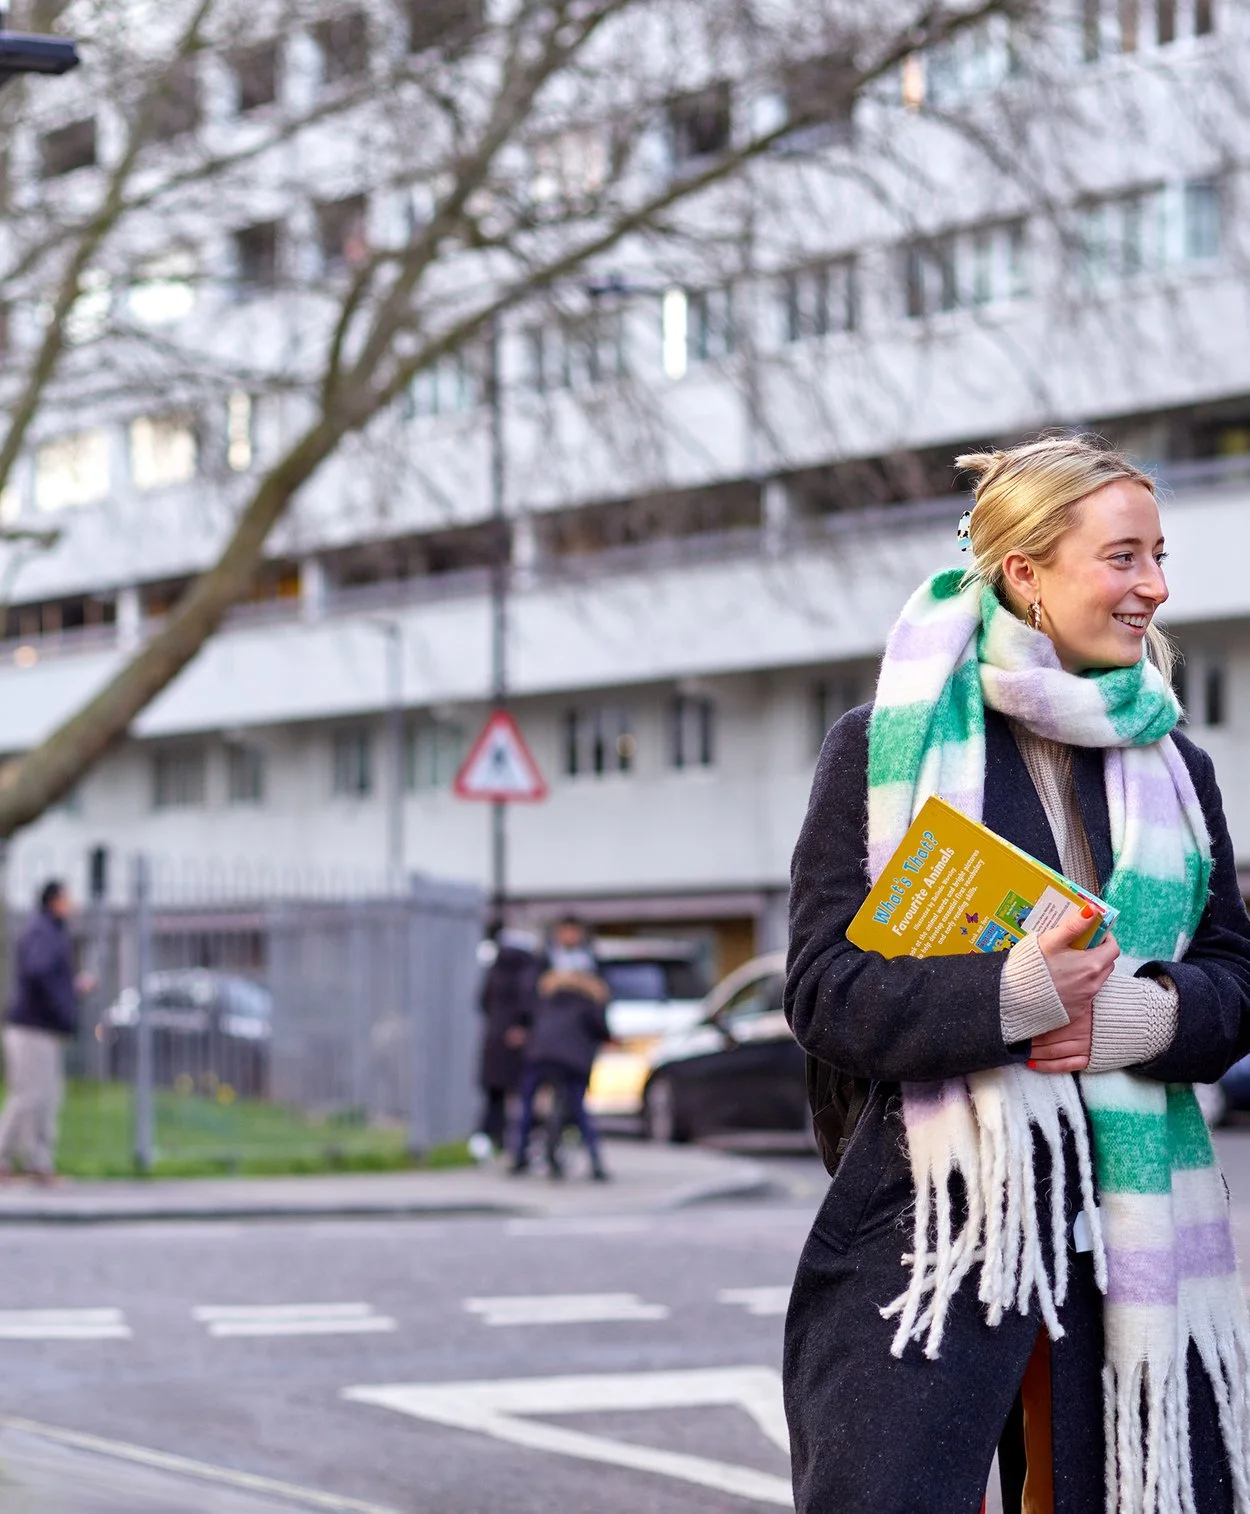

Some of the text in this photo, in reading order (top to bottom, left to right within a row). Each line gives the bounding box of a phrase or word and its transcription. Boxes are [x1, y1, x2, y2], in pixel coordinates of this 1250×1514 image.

[872, 830, 937, 924] What's That?
[892, 847, 954, 935] Favourite Animals
[918, 931, 927, 940] the
[925, 912, 938, 931] animal
[936, 897, 949, 913] words
[946, 886, 955, 897] and
[952, 870, 965, 887] bright
[963, 849, 979, 872] pictures
[920, 941, 932, 953] help
[928, 922, 944, 941] develop
[941, 898, 958, 922] essential
[963, 858, 984, 886] vocabulary
[937, 933, 946, 944] and
[944, 920, 956, 934] early
[953, 900, 969, 920] reading
